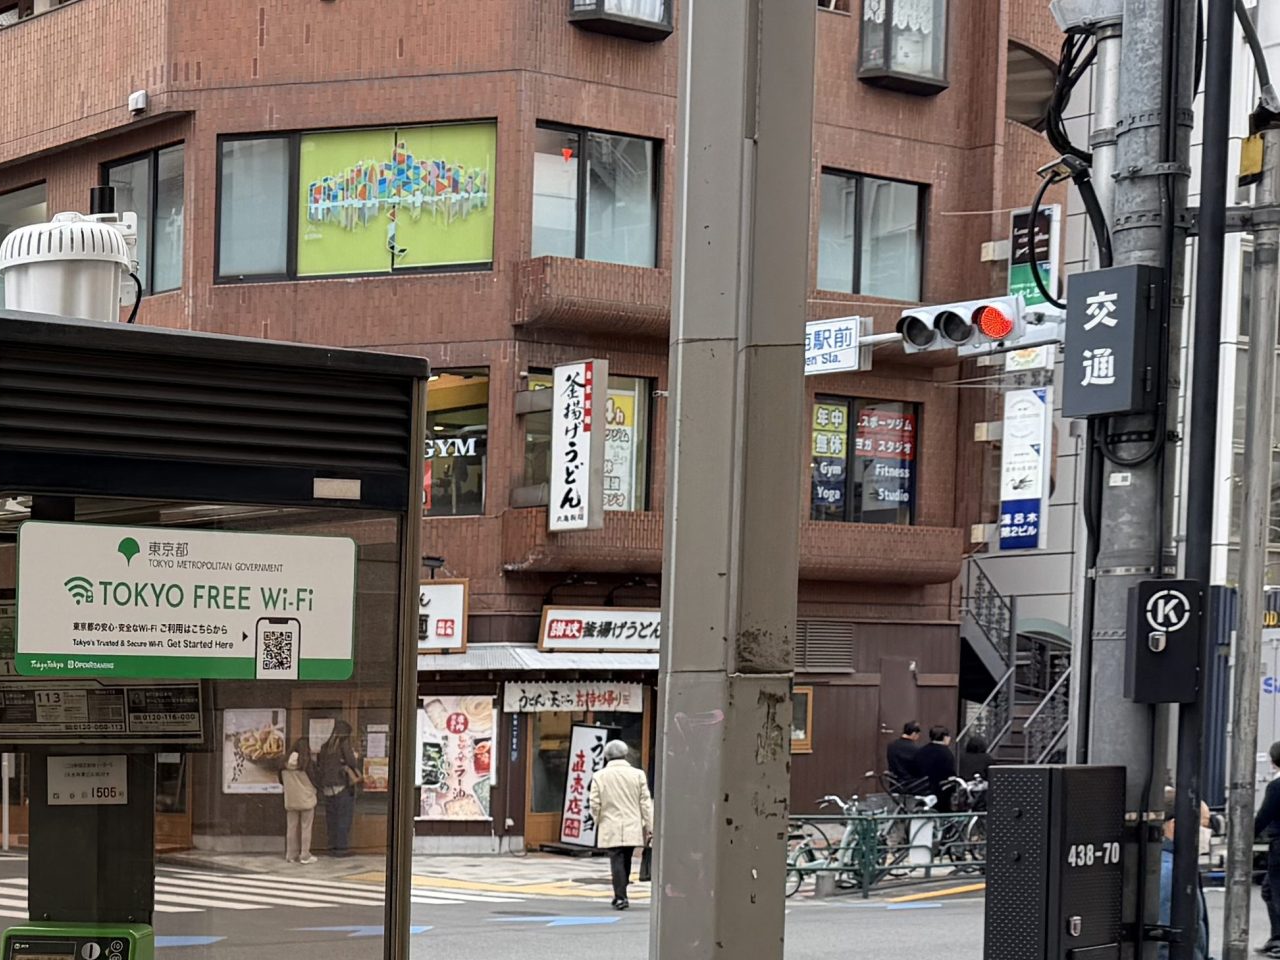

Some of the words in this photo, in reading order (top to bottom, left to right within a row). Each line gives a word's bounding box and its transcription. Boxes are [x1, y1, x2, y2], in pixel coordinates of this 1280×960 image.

[1081, 291, 1119, 386] 交通
[816, 407, 844, 427] 年中
[861, 416, 913, 431] スポーツジム
[560, 371, 587, 509] 釜揚げうどん
[815, 435, 843, 455] 無休
[855, 437, 873, 451] ヨガ
[878, 440, 912, 453] スタジオ
[820, 462, 842, 477] Gym
[874, 464, 911, 479] Fitness
[816, 485, 841, 502] Yoga
[877, 487, 910, 502] Studio
[148, 541, 189, 557] 東京都
[148, 558, 174, 568] TOKYO
[176, 560, 233, 571] METROPOLITAN
[235, 562, 284, 573] GOVERNMENT
[99, 581, 184, 608] TOKYO
[194, 585, 251, 610] FREE
[260, 587, 314, 611] Wi-Fi
[160, 623, 228, 634] ご利用はこちらから
[549, 620, 581, 638] 讃岐
[583, 620, 661, 640] 釜揚げうどん
[73, 638, 95, 647] Tokyo's
[97, 639, 119, 647] Trusted
[127, 640, 147, 648] Secure
[167, 639, 181, 648] Get
[183, 639, 213, 649] Started
[215, 640, 234, 650] Here
[36, 692, 61, 704] 113
[566, 749, 586, 815] 直売店
[583, 735, 604, 832] うど当
[91, 786, 117, 798] 1505
[1068, 843, 1121, 867] 438-70
